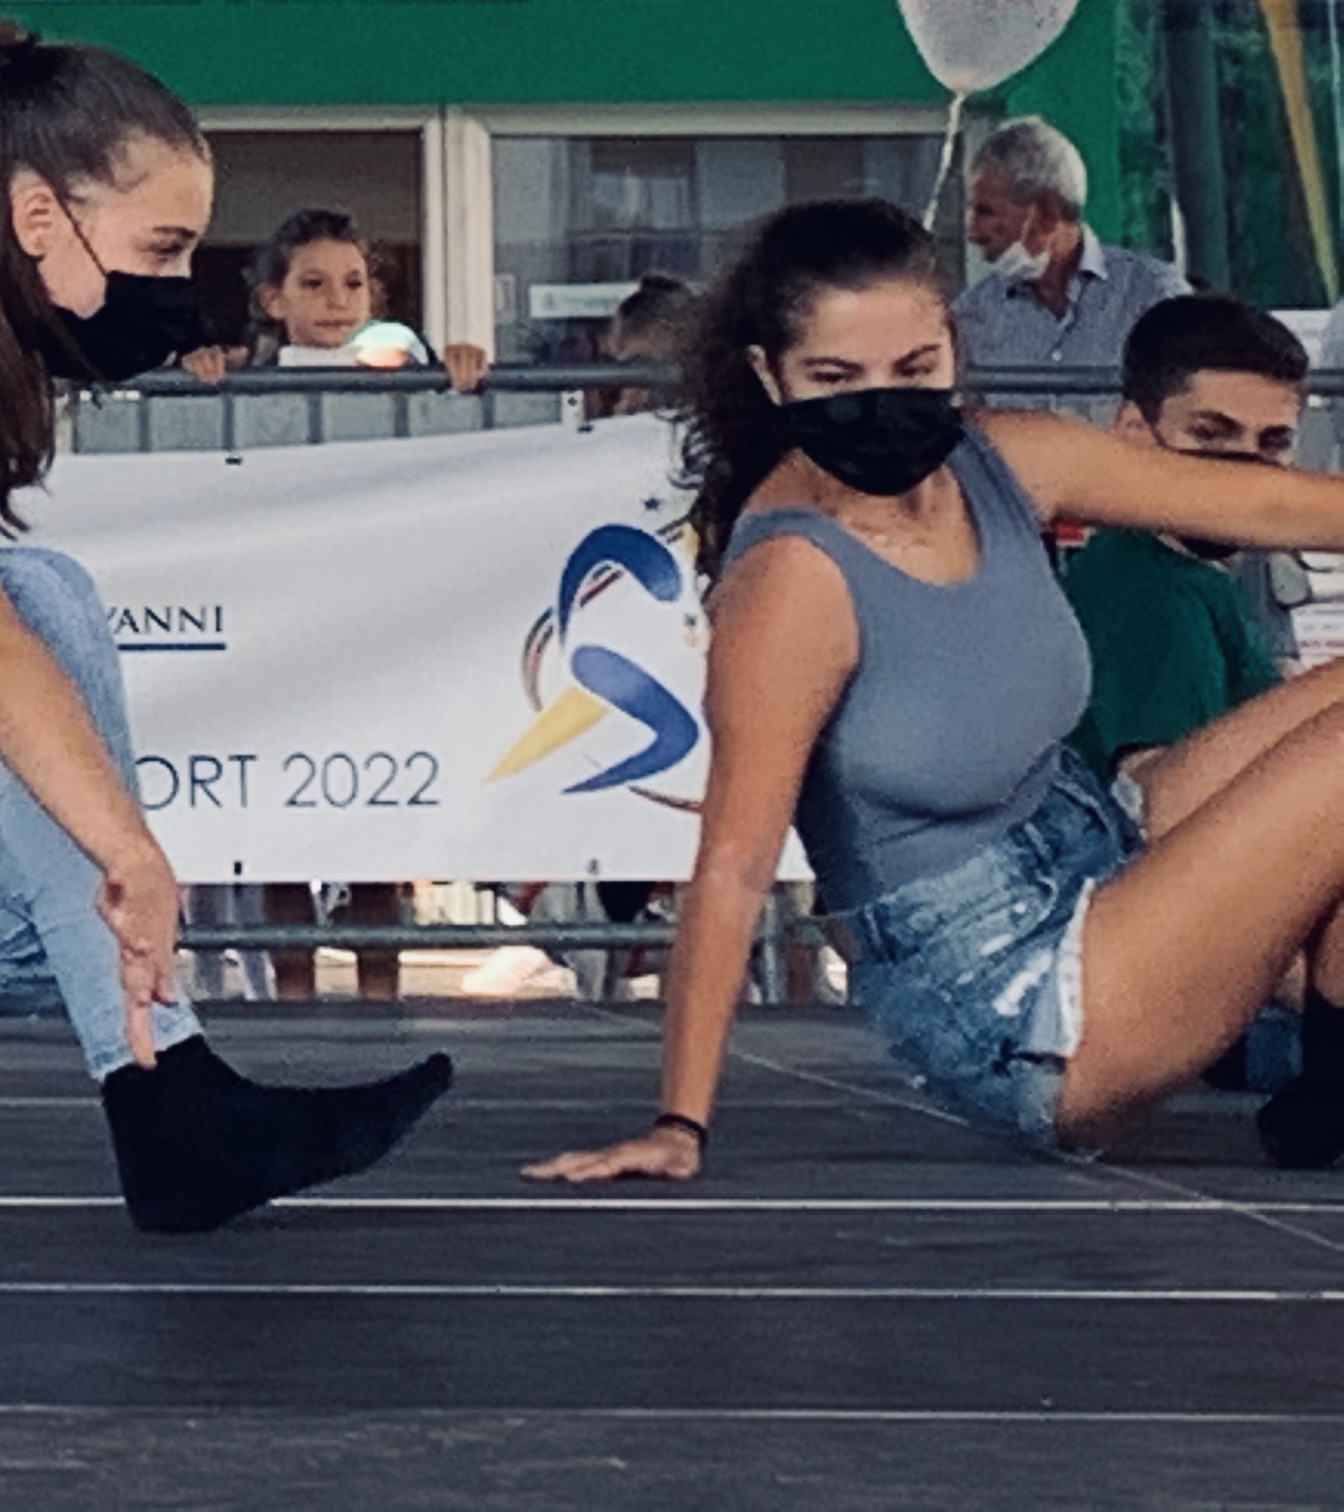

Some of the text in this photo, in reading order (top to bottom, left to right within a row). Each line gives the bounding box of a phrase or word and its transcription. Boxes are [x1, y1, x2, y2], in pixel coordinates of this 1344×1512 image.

[110, 605, 224, 635] ANNI
[135, 750, 440, 811] ORT 2022
